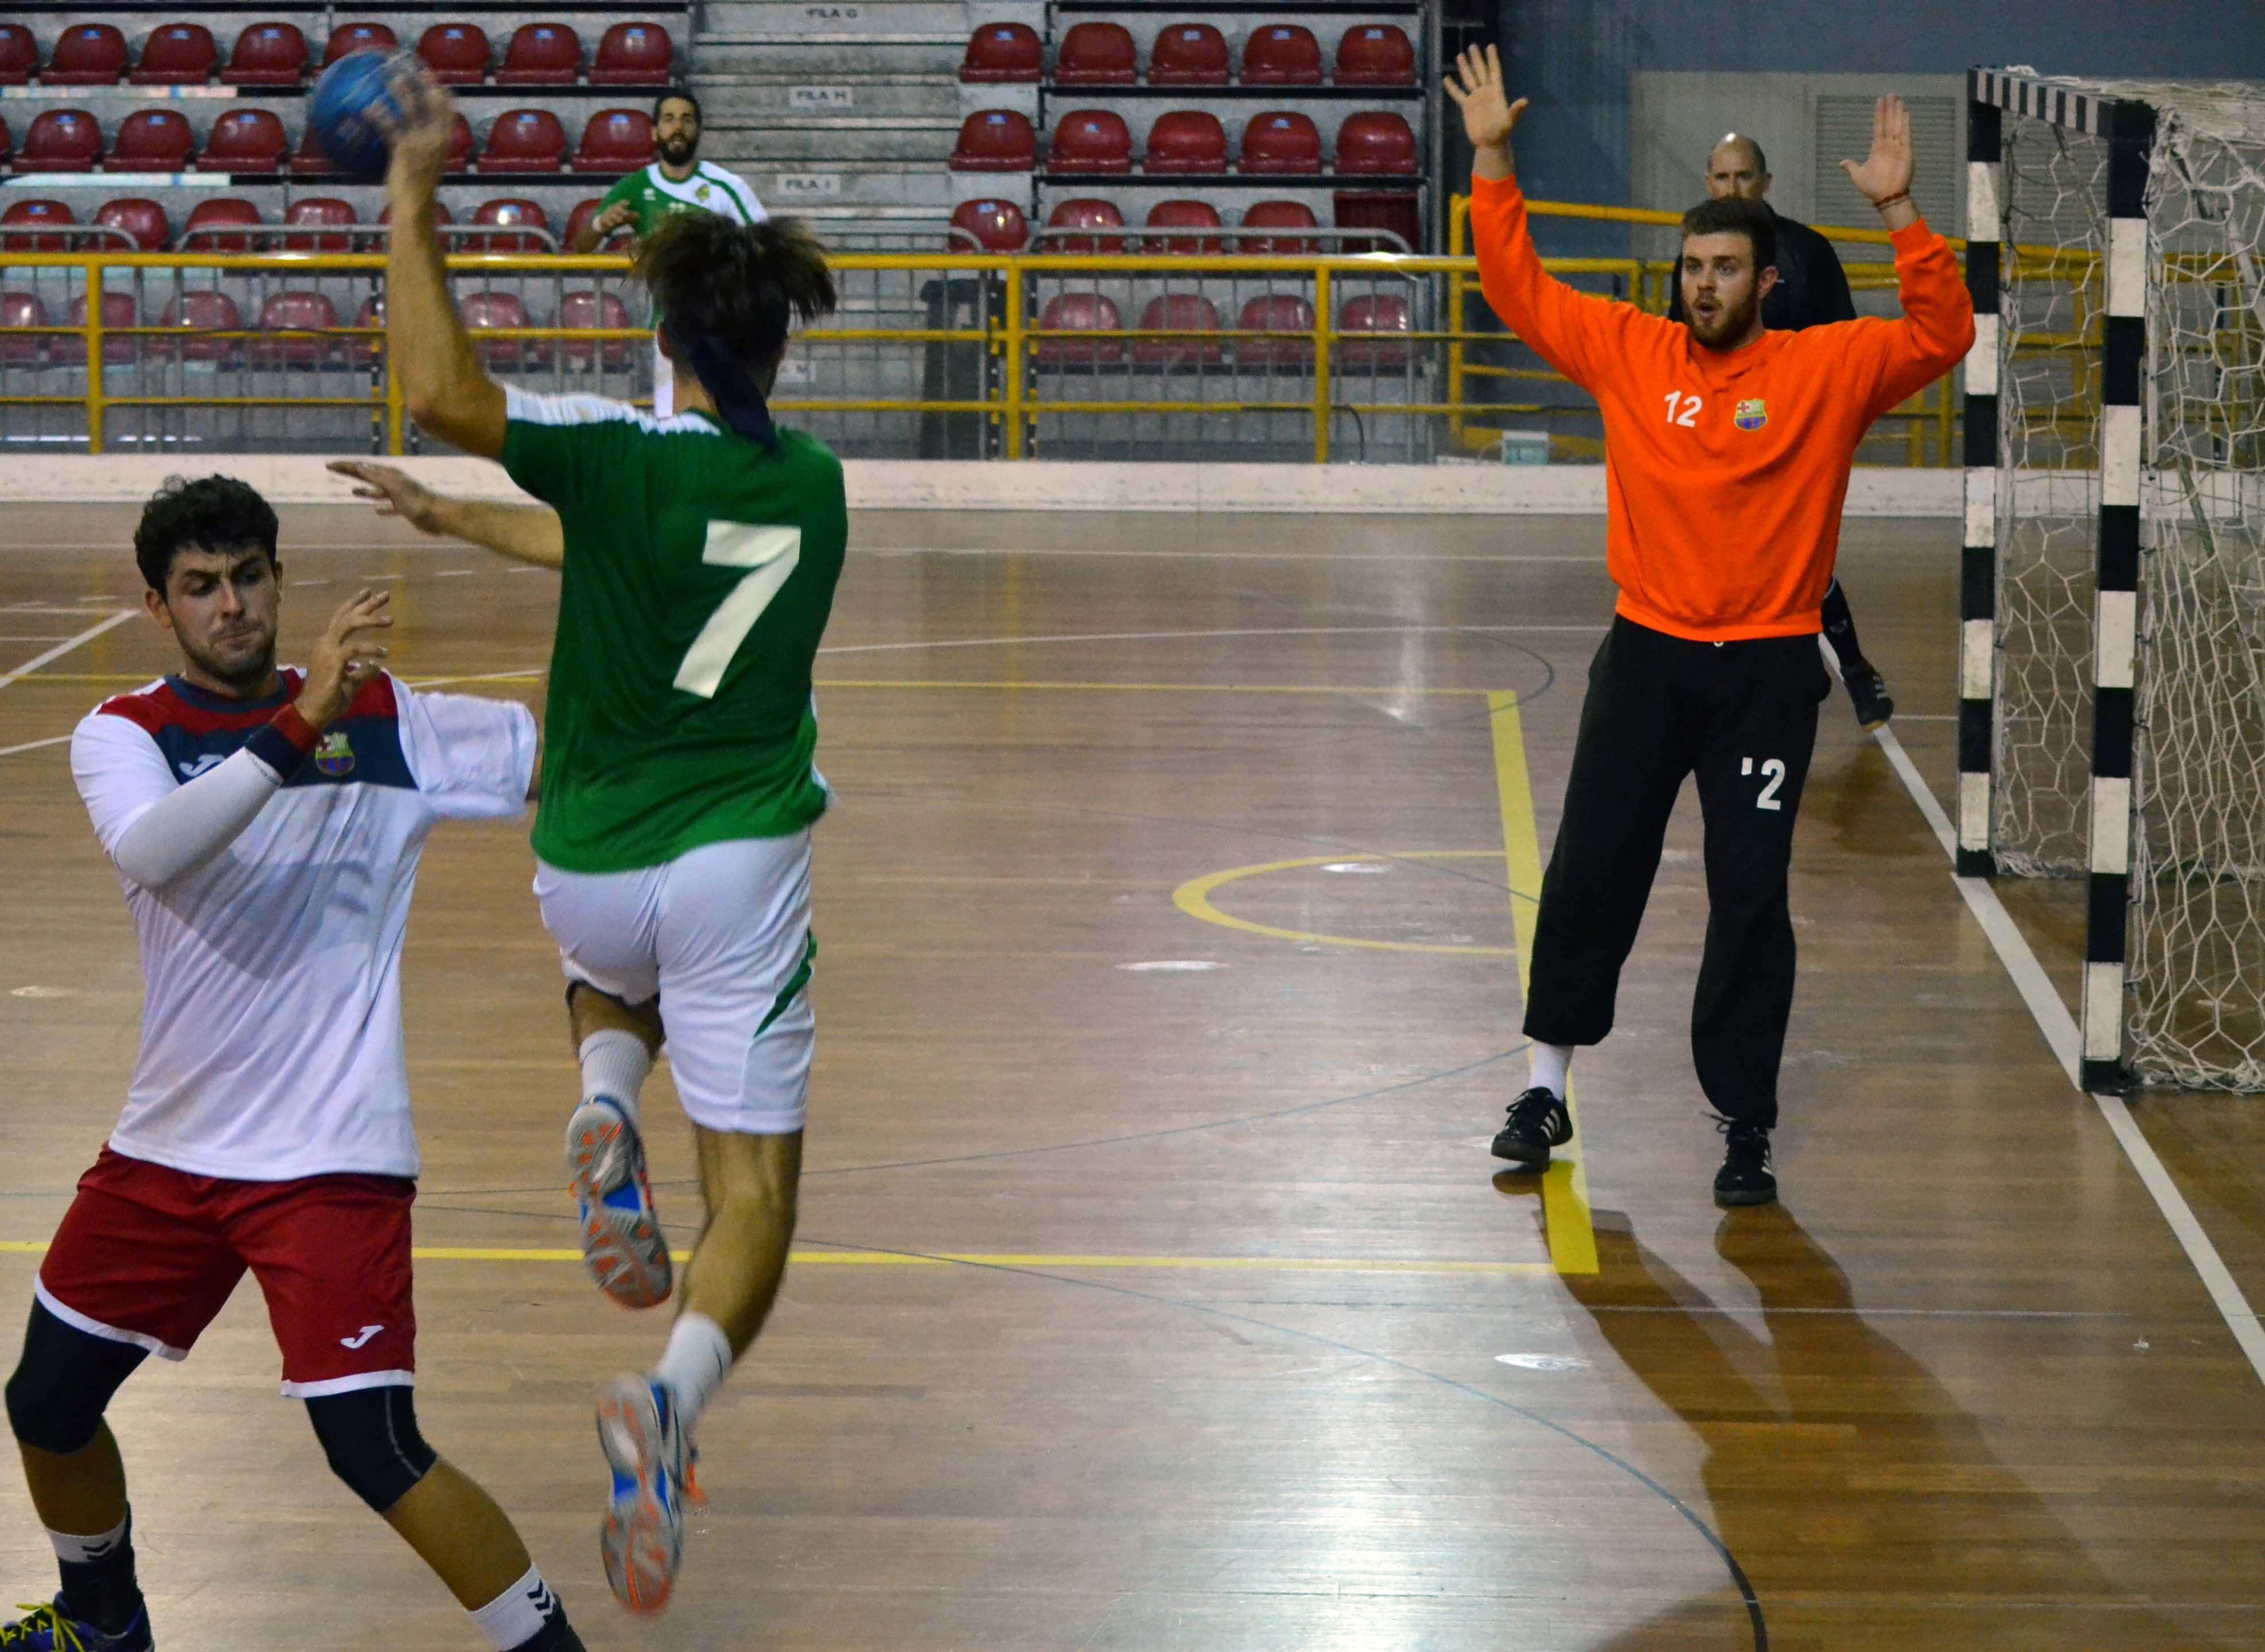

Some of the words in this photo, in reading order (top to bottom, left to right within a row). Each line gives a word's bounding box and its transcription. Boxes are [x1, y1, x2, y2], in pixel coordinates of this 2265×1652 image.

[805, 8, 841, 18] FILA
[796, 91, 829, 101] FILA
[785, 180, 818, 189] FILA
[1664, 390, 1703, 428] 12
[672, 519, 801, 699] 7
